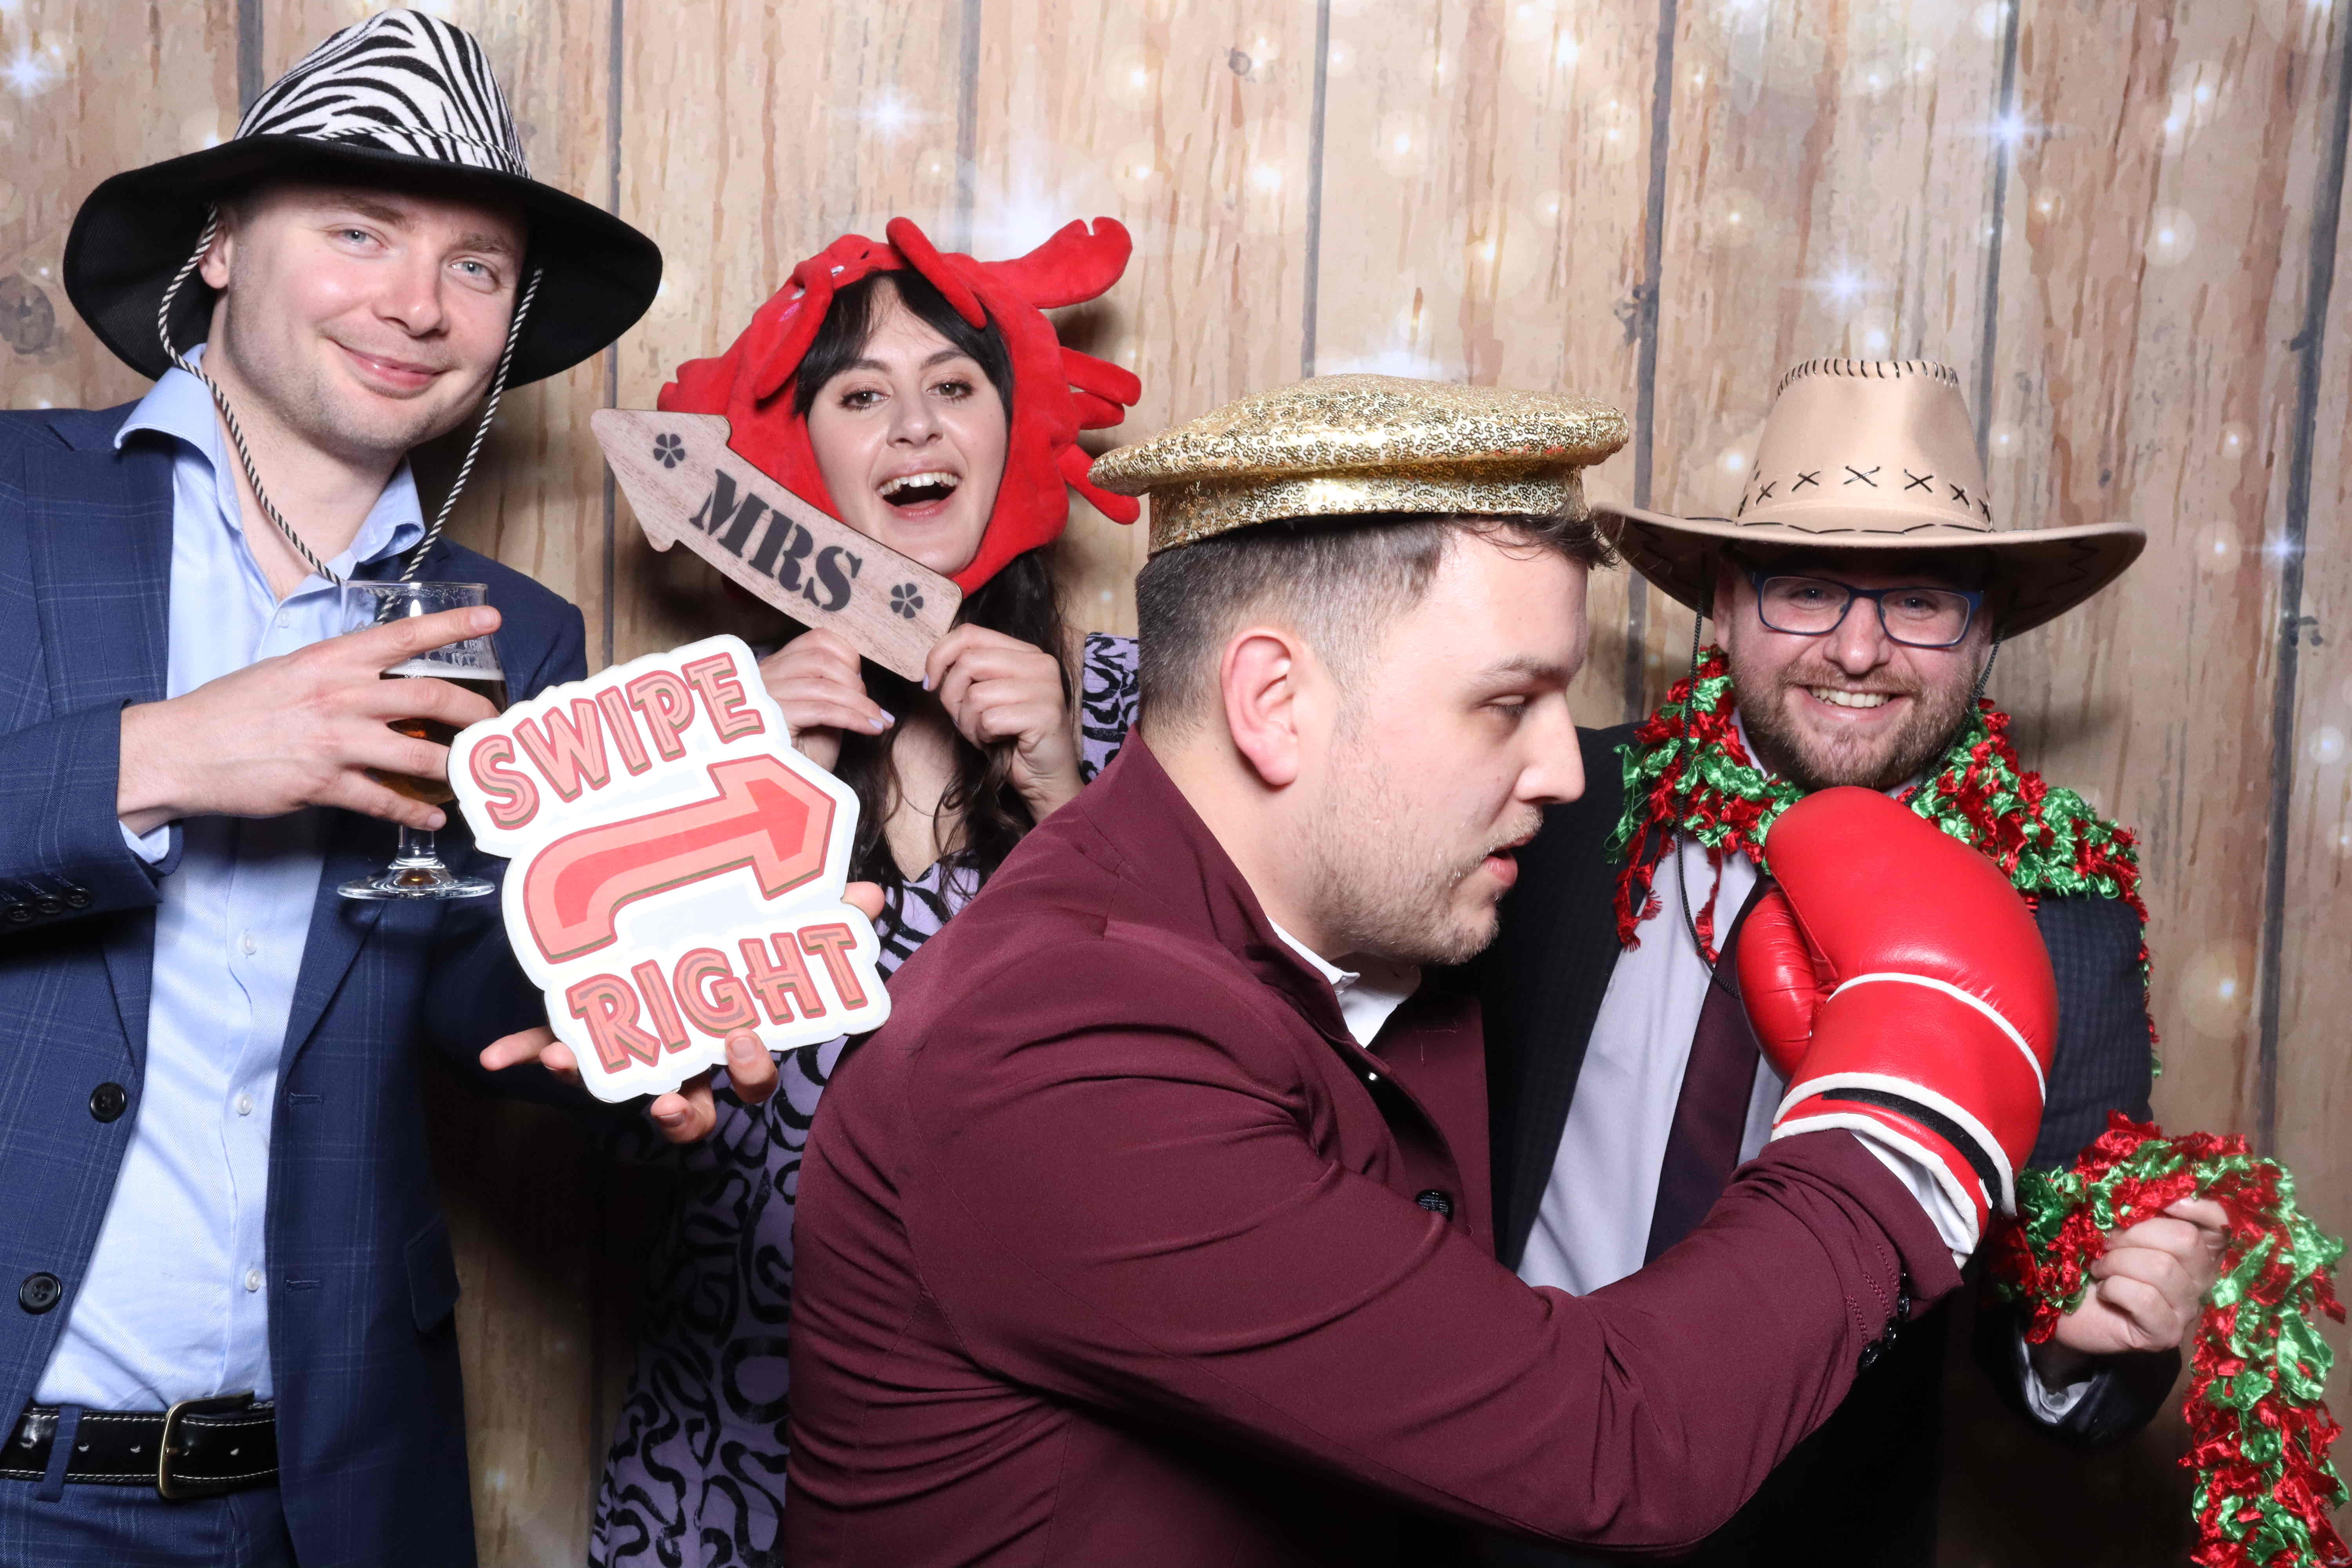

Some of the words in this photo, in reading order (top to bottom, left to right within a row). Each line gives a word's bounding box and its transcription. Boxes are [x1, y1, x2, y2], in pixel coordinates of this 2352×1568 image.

[689, 469, 862, 612] MRS
[469, 652, 765, 830] SWIPE
[565, 923, 868, 1074] RIGHT
